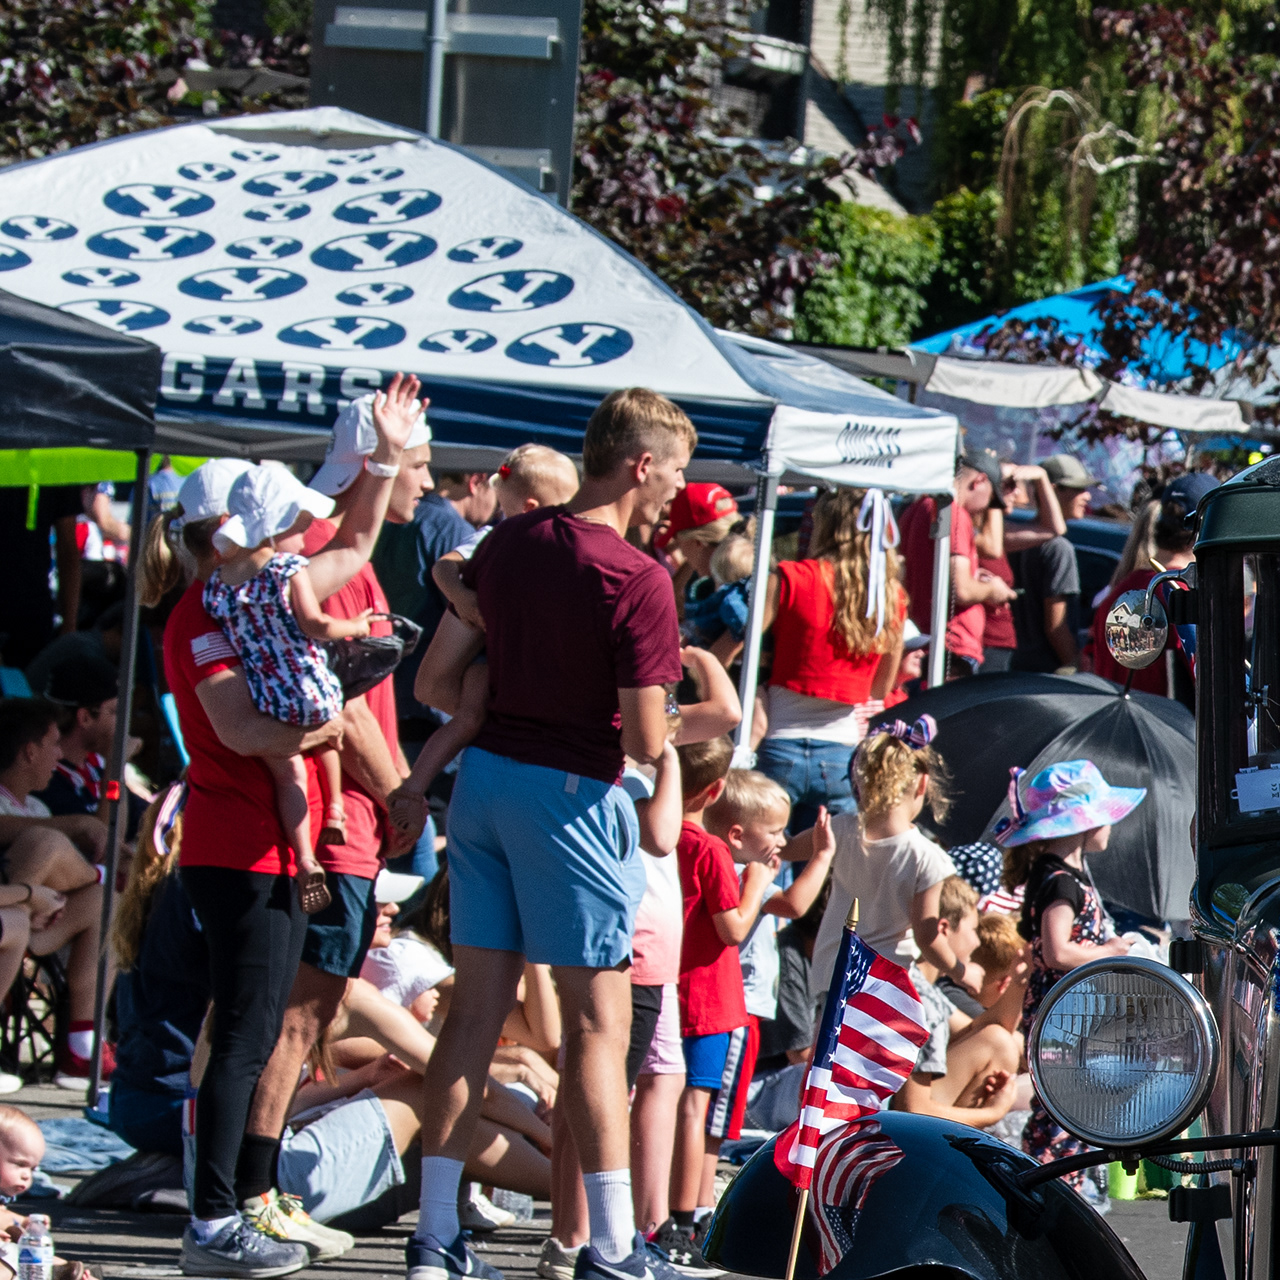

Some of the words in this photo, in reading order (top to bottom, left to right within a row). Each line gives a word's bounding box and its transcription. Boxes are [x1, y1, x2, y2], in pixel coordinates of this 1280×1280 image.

[253, 170, 328, 197] Y
[117, 184, 203, 219] Y
[345, 189, 429, 224] Y
[8, 215, 71, 241] Y
[102, 226, 200, 261] Y
[234, 236, 295, 261] Y
[326, 231, 422, 271] Y
[456, 237, 515, 263] Y
[71, 267, 132, 288] Y
[194, 268, 291, 301] Y
[461, 270, 559, 312] Y
[345, 282, 405, 306] Y
[194, 315, 252, 336] Y
[293, 316, 390, 350] Y
[427, 329, 488, 354] Y
[520, 324, 617, 367] Y
